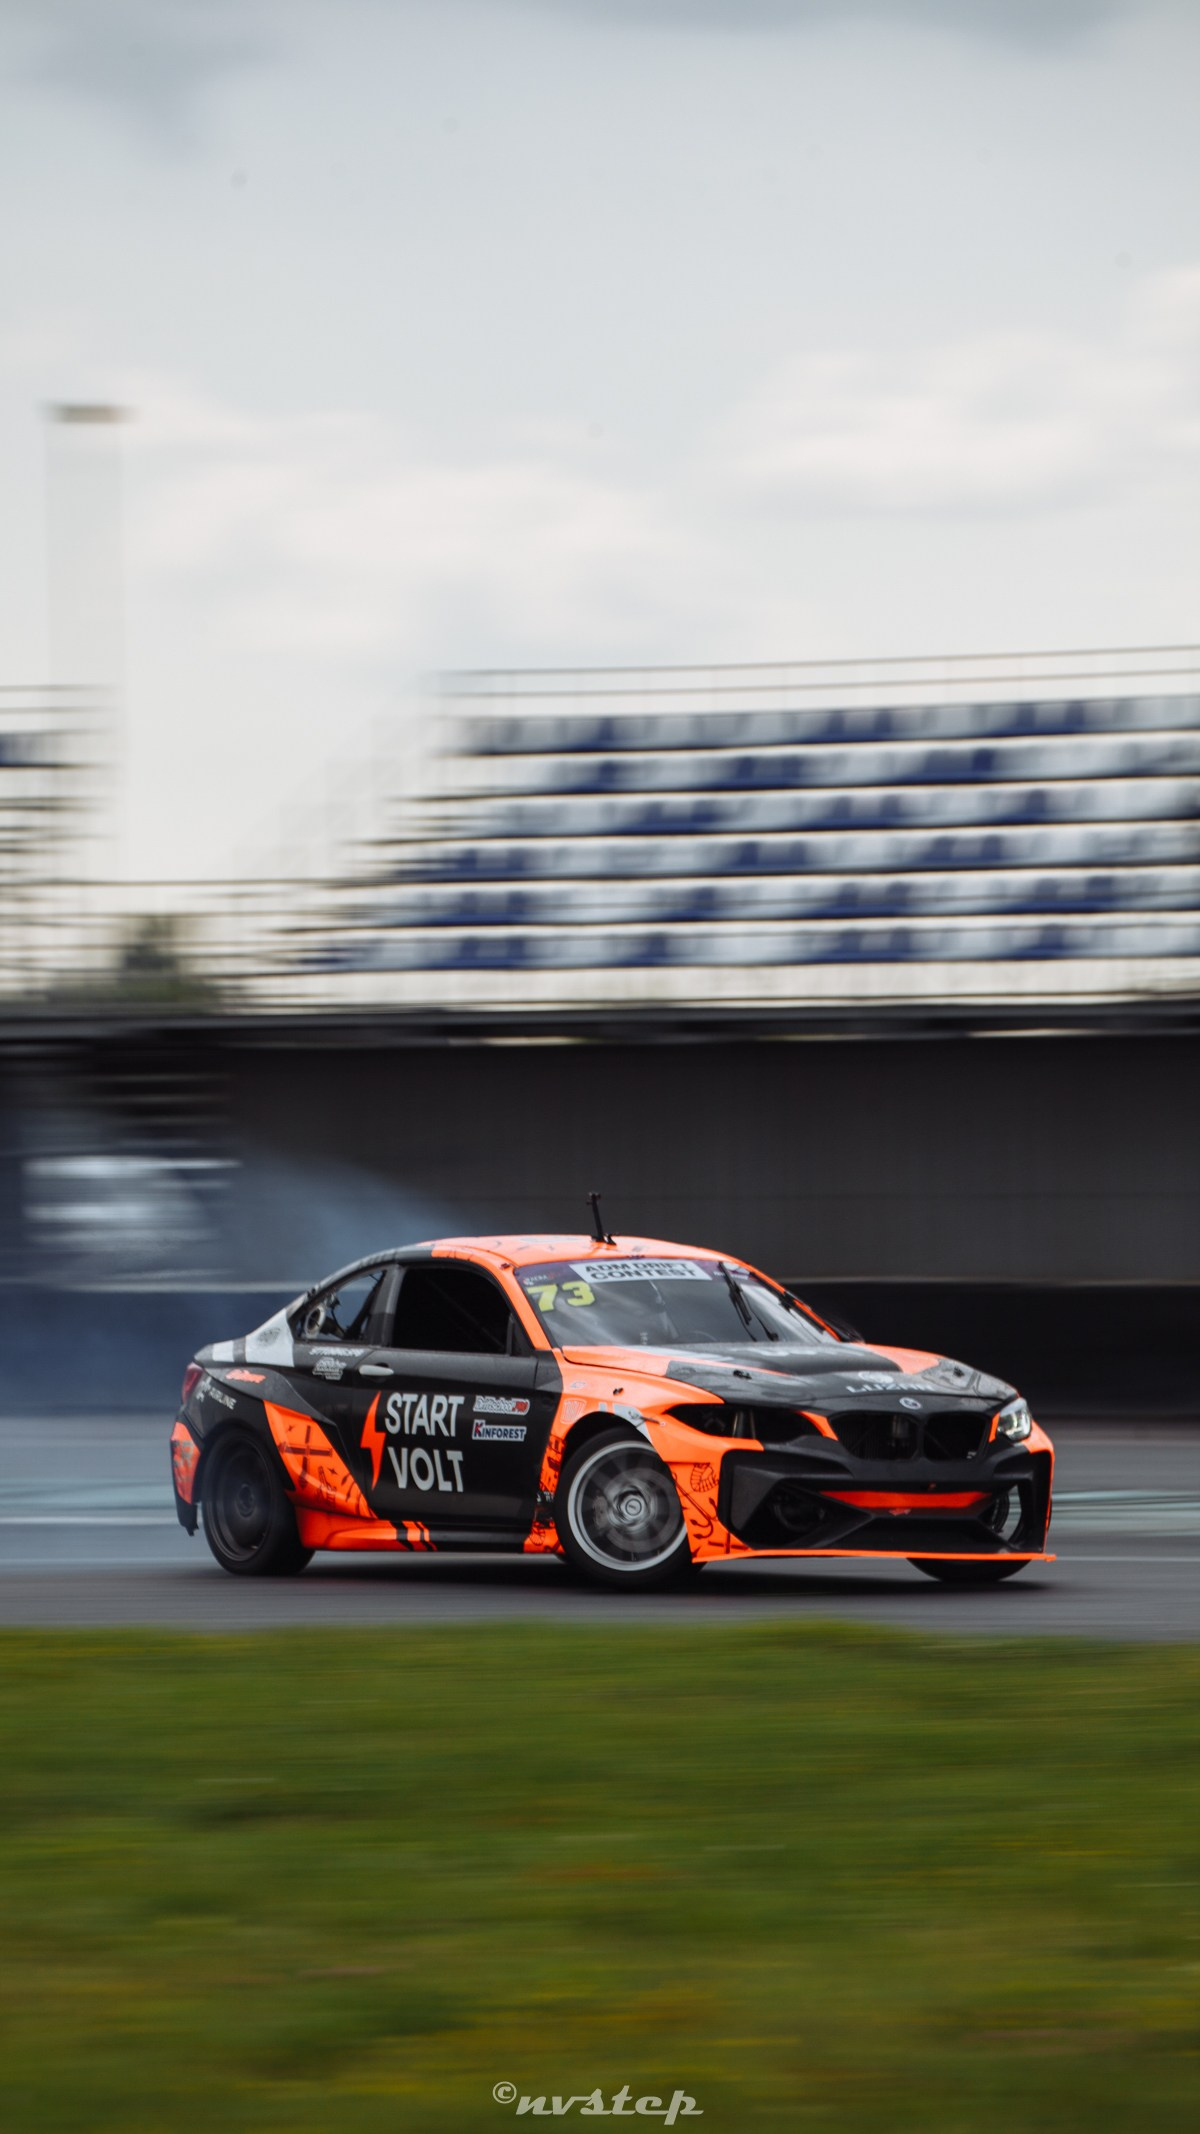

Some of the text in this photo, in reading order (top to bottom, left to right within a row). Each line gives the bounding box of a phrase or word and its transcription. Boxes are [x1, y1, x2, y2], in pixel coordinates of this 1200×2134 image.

[585, 1261, 689, 1273] ADM DRIFT
[591, 1268, 697, 1280] CONTEST
[527, 1280, 595, 1312] 73
[385, 1392, 465, 1437] START
[474, 1422, 525, 1439] KINFOREST
[387, 1446, 464, 1492] VOLT
